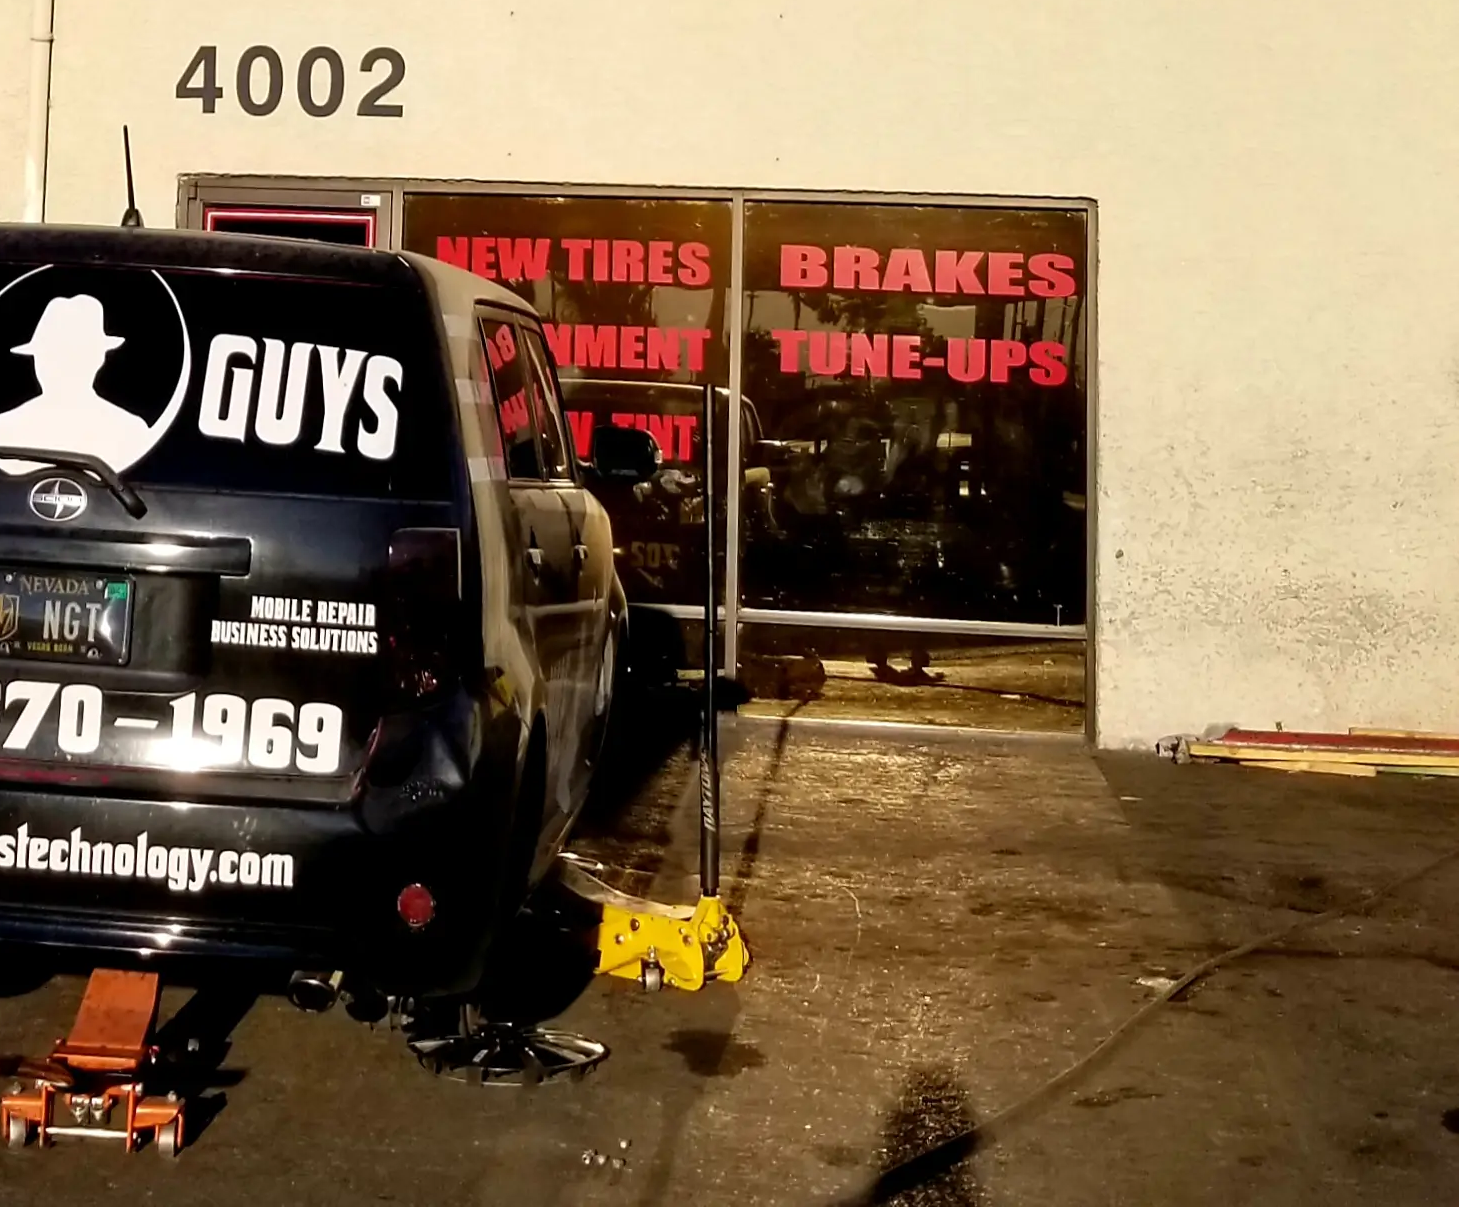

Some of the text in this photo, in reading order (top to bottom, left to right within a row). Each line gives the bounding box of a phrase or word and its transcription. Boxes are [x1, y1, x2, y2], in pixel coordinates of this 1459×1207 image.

[175, 45, 406, 118] 4002
[436, 236, 713, 286] NEW TIRES
[779, 243, 1077, 299] BRAKES
[541, 323, 712, 372] NMENT
[770, 328, 1069, 386] TUNE-UPS
[198, 333, 403, 460] GUYS
[19, 576, 89, 595] NEVADA
[43, 600, 102, 642] NGT
[250, 595, 376, 626] MOBILE REPAIR
[210, 620, 378, 654] BUSINESS SOLUTIONS
